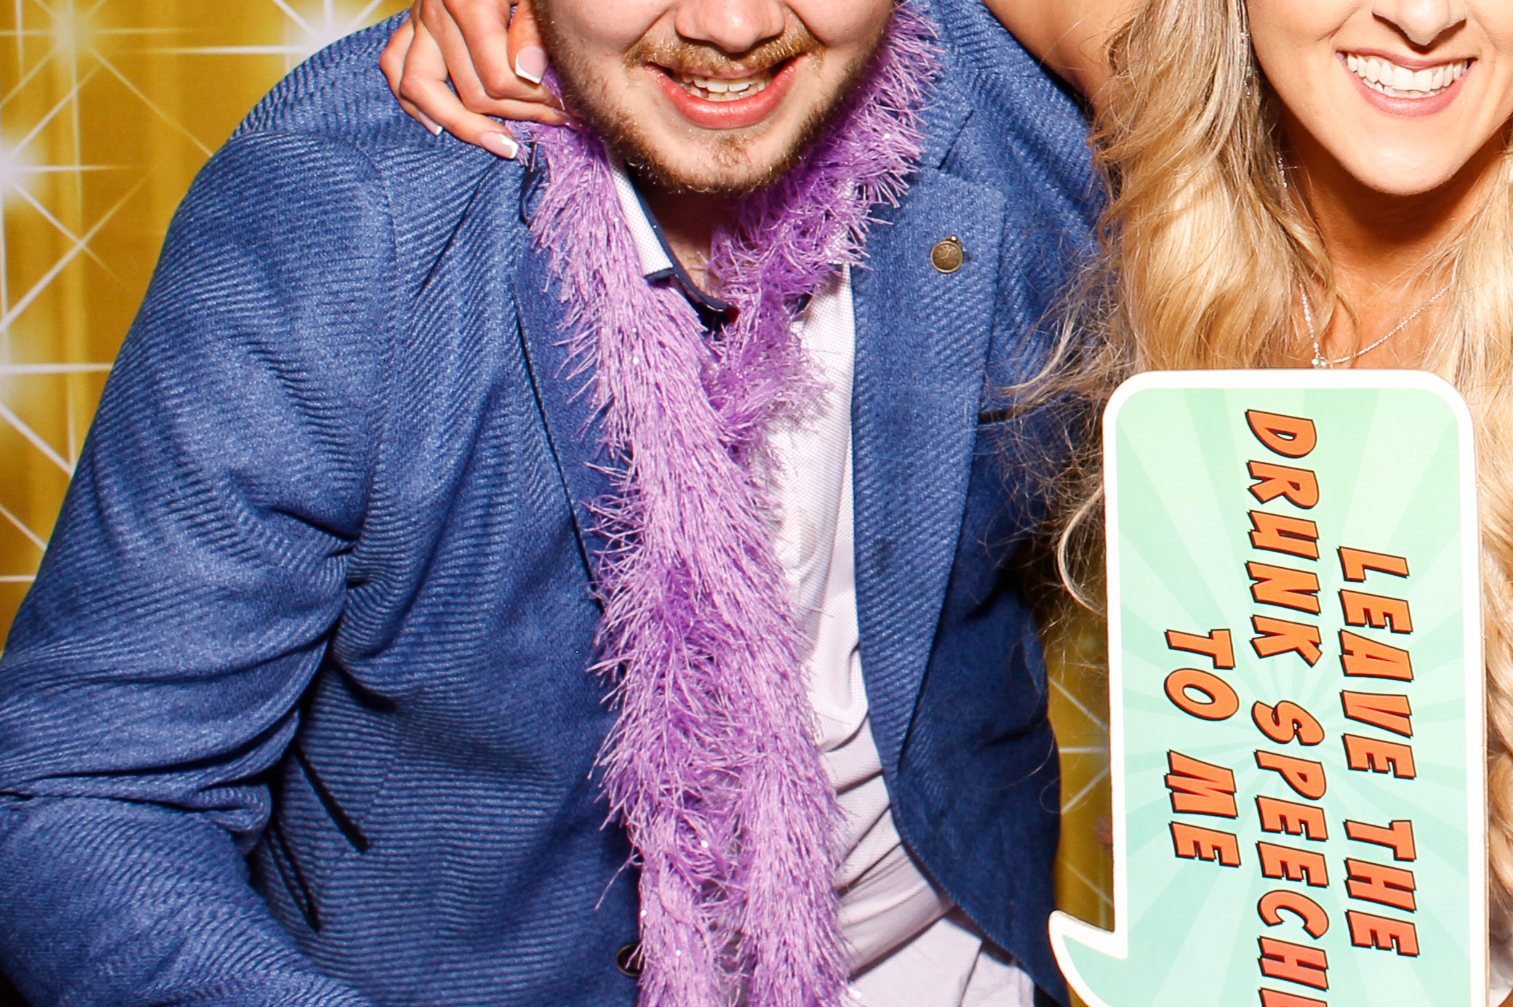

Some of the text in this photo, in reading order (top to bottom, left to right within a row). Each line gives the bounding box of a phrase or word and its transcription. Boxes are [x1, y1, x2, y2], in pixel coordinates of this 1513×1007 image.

[1244, 408, 1323, 667] DRUNK
[1163, 628, 1242, 868] TO ME
[1337, 545, 1420, 958] LEAVE THE
